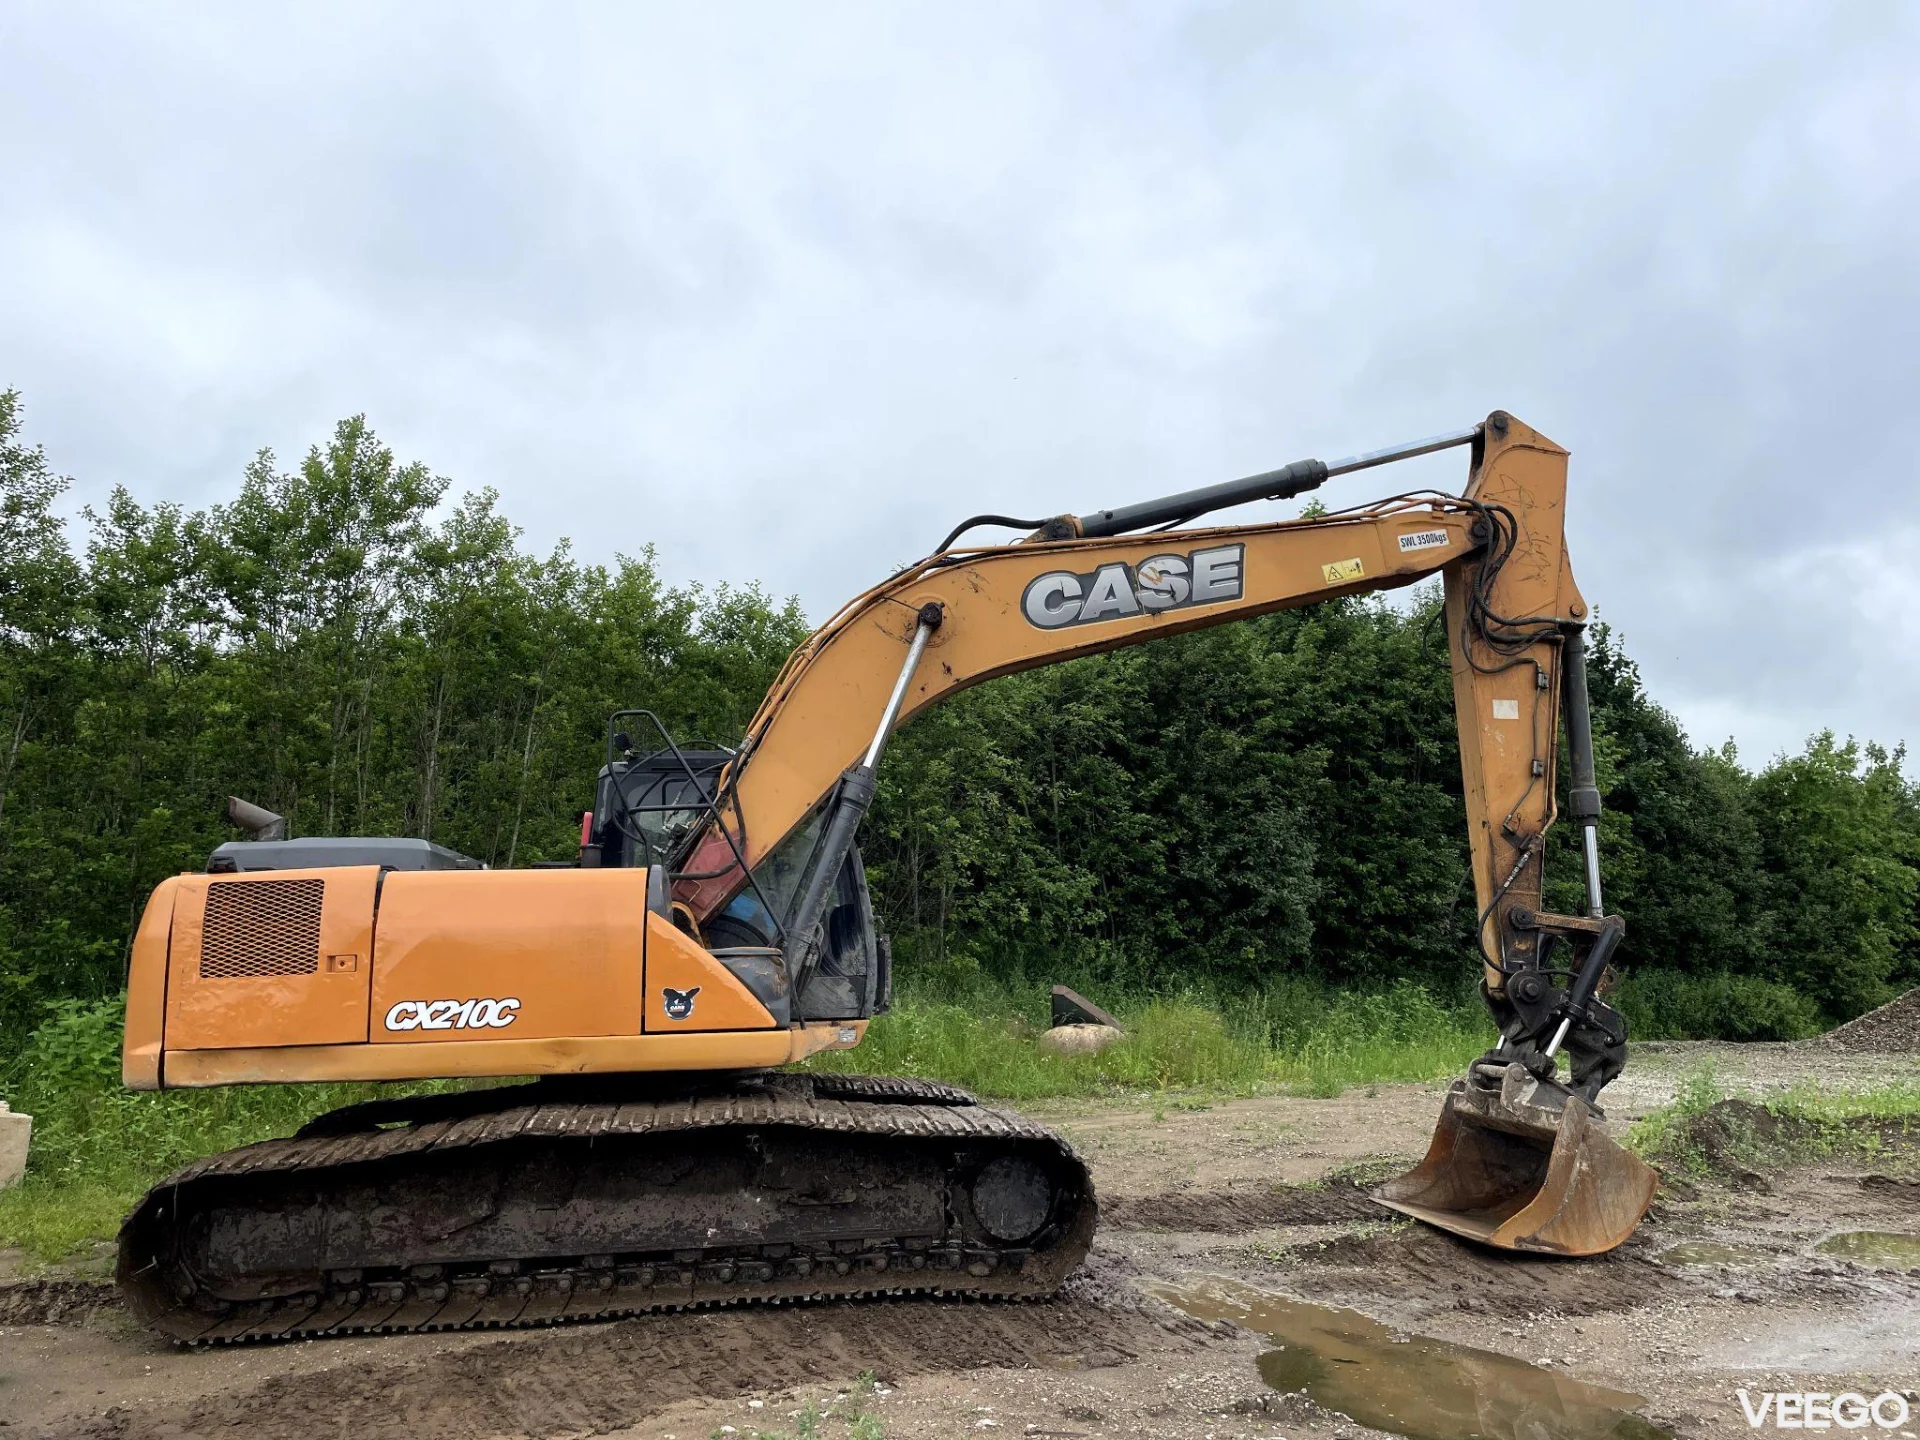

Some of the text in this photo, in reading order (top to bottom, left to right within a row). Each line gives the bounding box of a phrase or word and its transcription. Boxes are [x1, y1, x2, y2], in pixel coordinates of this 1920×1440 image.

[1400, 536, 1417, 548] SWL
[1024, 547, 1241, 627] CASE
[385, 997, 521, 1031] CX210C
